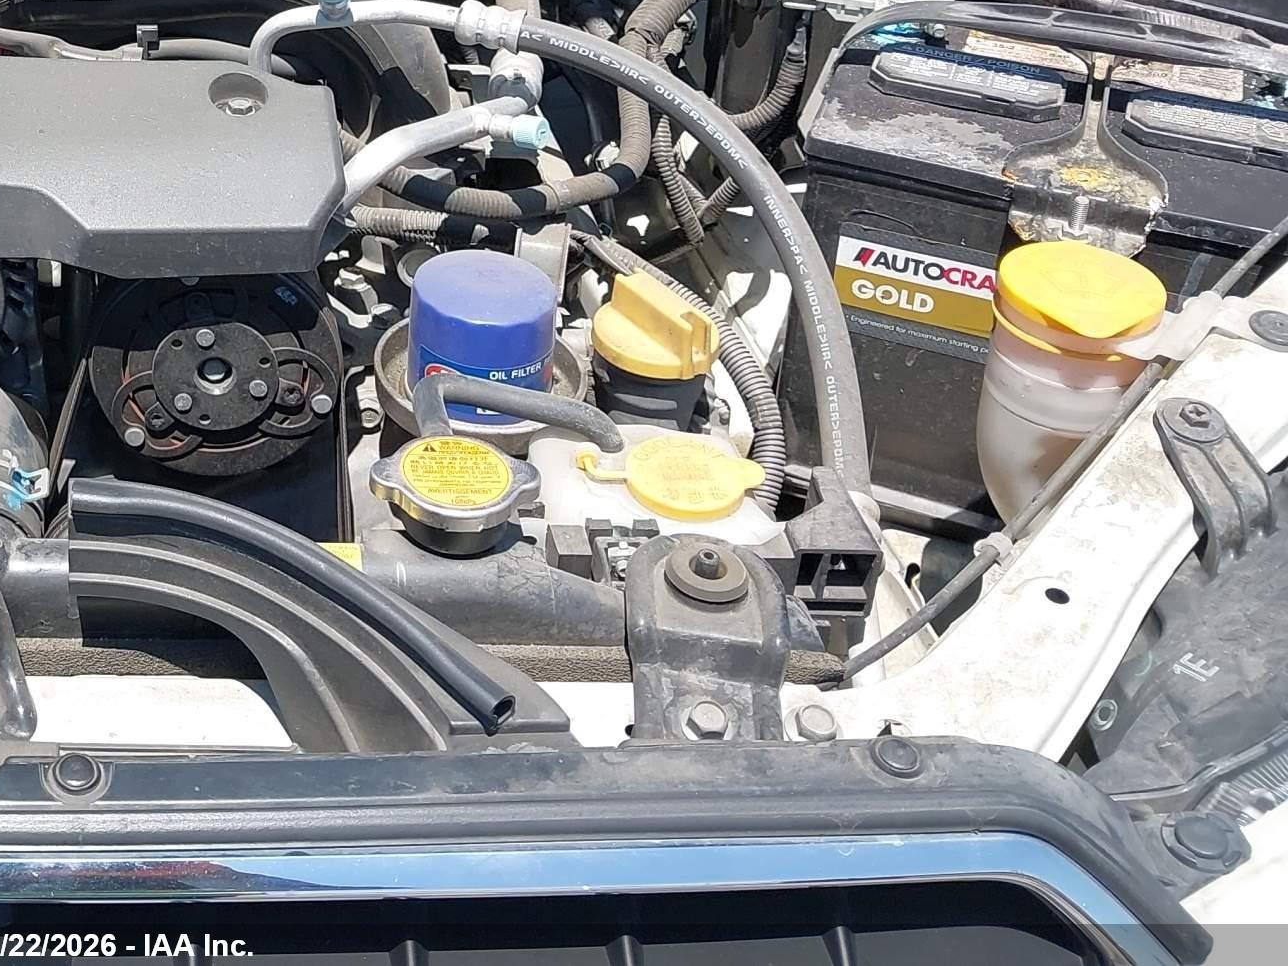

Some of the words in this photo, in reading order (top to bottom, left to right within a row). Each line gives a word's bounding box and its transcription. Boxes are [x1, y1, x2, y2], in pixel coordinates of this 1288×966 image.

[915, 46, 974, 62] DANGER
[987, 59, 1041, 74] POISON
[851, 278, 935, 314] GOLD
[850, 315, 895, 333] Engineered
[895, 325, 907, 334] for
[908, 329, 948, 344] maximum
[949, 338, 979, 353] starting
[489, 370, 508, 380] OIL
[511, 362, 542, 379] FILTER
